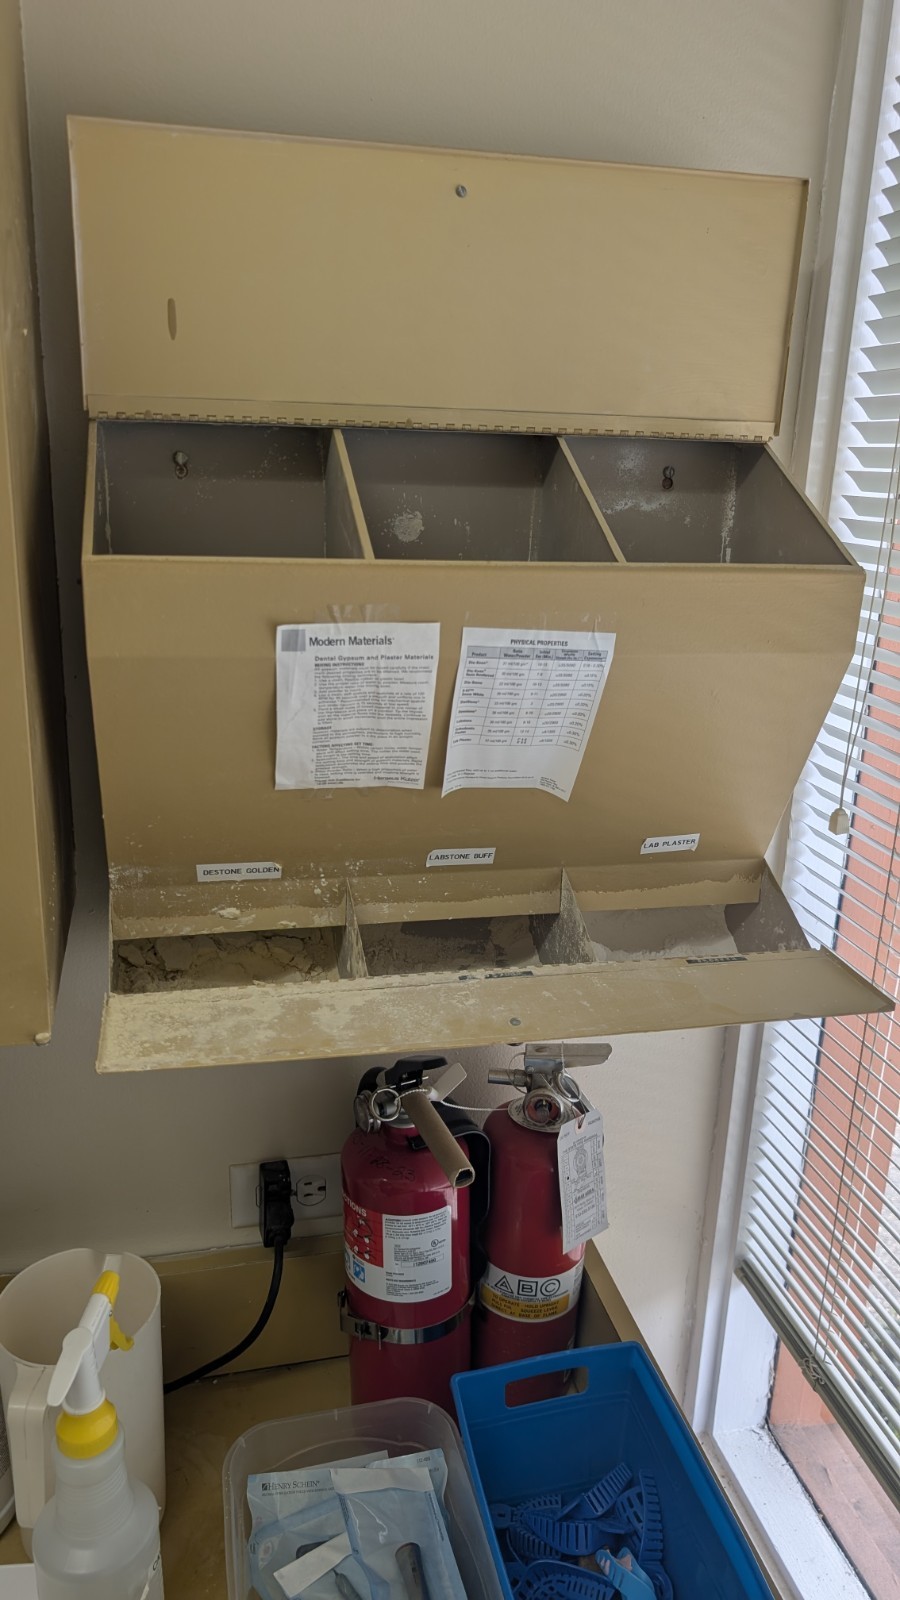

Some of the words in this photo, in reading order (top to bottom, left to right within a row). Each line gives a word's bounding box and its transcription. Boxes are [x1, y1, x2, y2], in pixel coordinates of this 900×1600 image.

[309, 636, 345, 647] Modern
[349, 635, 393, 646] Materials
[338, 655, 365, 663] Gypsum
[662, 838, 696, 847] PLASTER
[428, 853, 470, 861] LABSTONE
[203, 868, 242, 876] DESTONE
[246, 866, 280, 874] GOLDEN
[499, 1295, 520, 1307] OPERATE
[268, 1482, 292, 1491] HENRY
